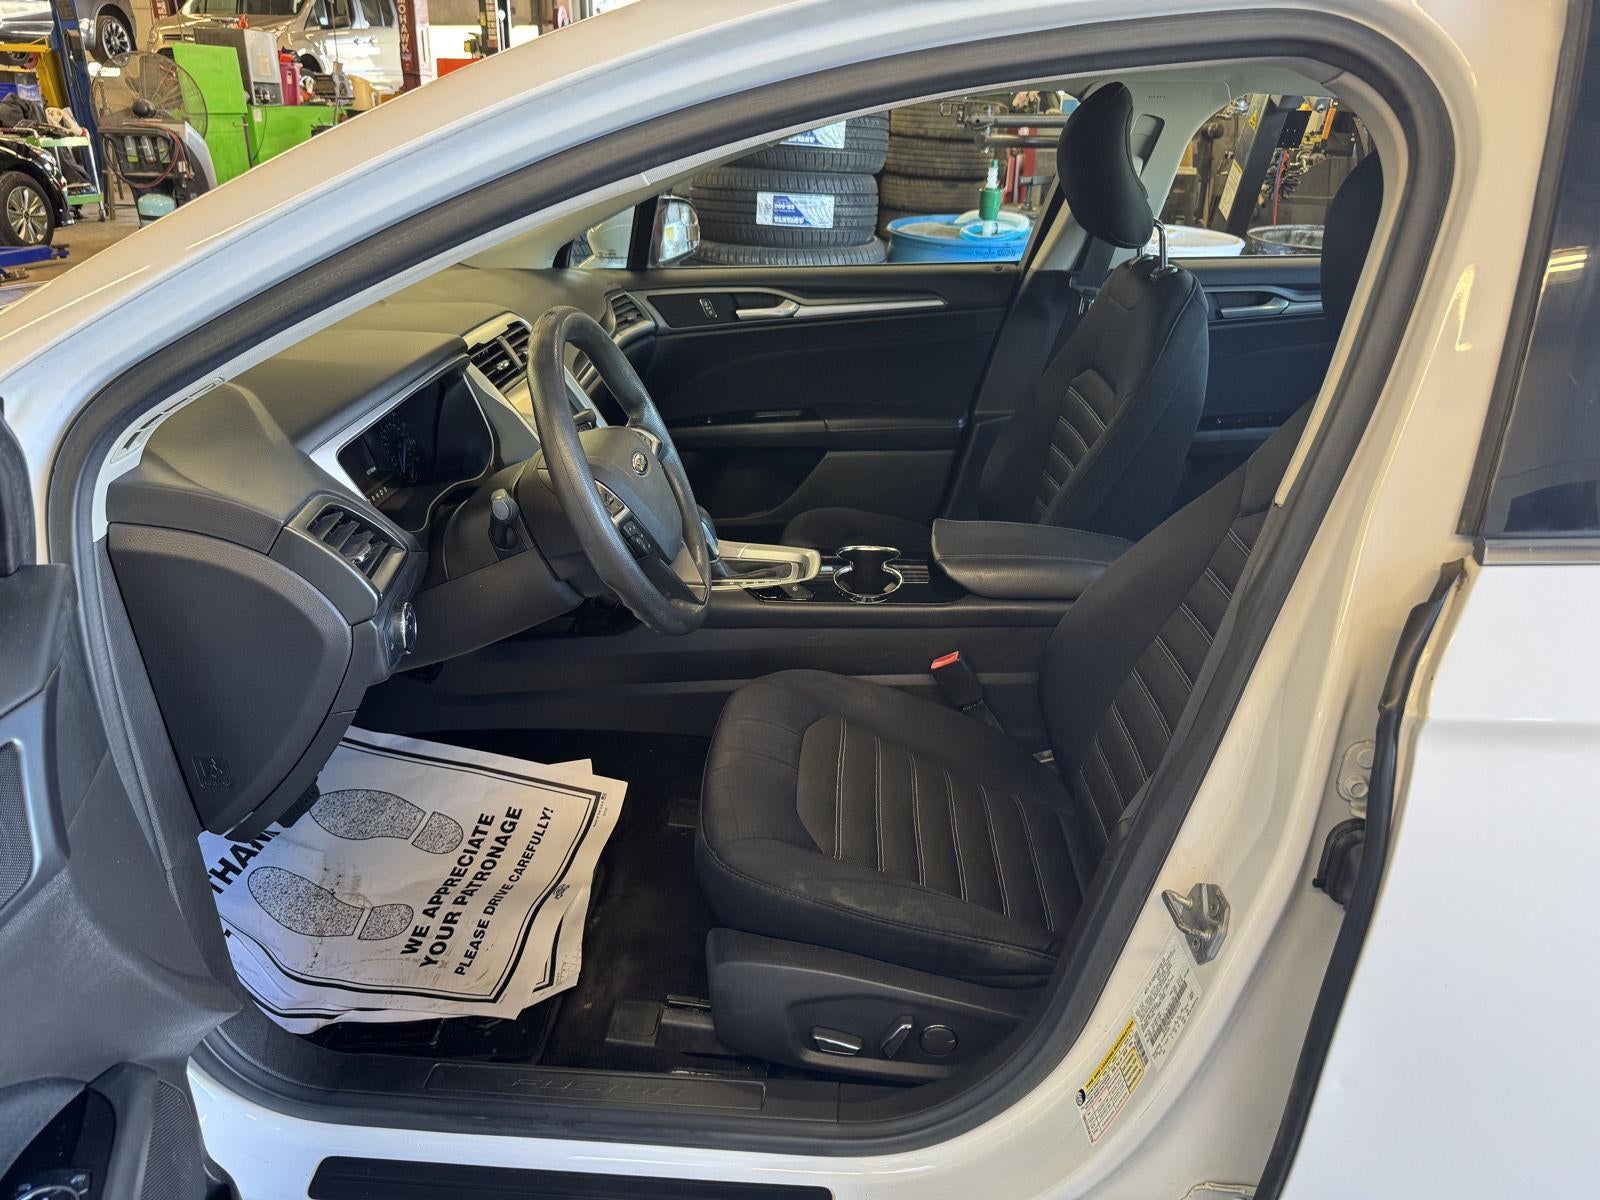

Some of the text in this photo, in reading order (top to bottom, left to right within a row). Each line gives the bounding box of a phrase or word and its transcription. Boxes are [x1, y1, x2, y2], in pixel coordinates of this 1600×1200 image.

[400, 813, 495, 954] WE APPRECIATE
[418, 806, 523, 968] YOUR PATRONAGE
[454, 806, 554, 976] PLEASE DRIVE CAREFULLY!
